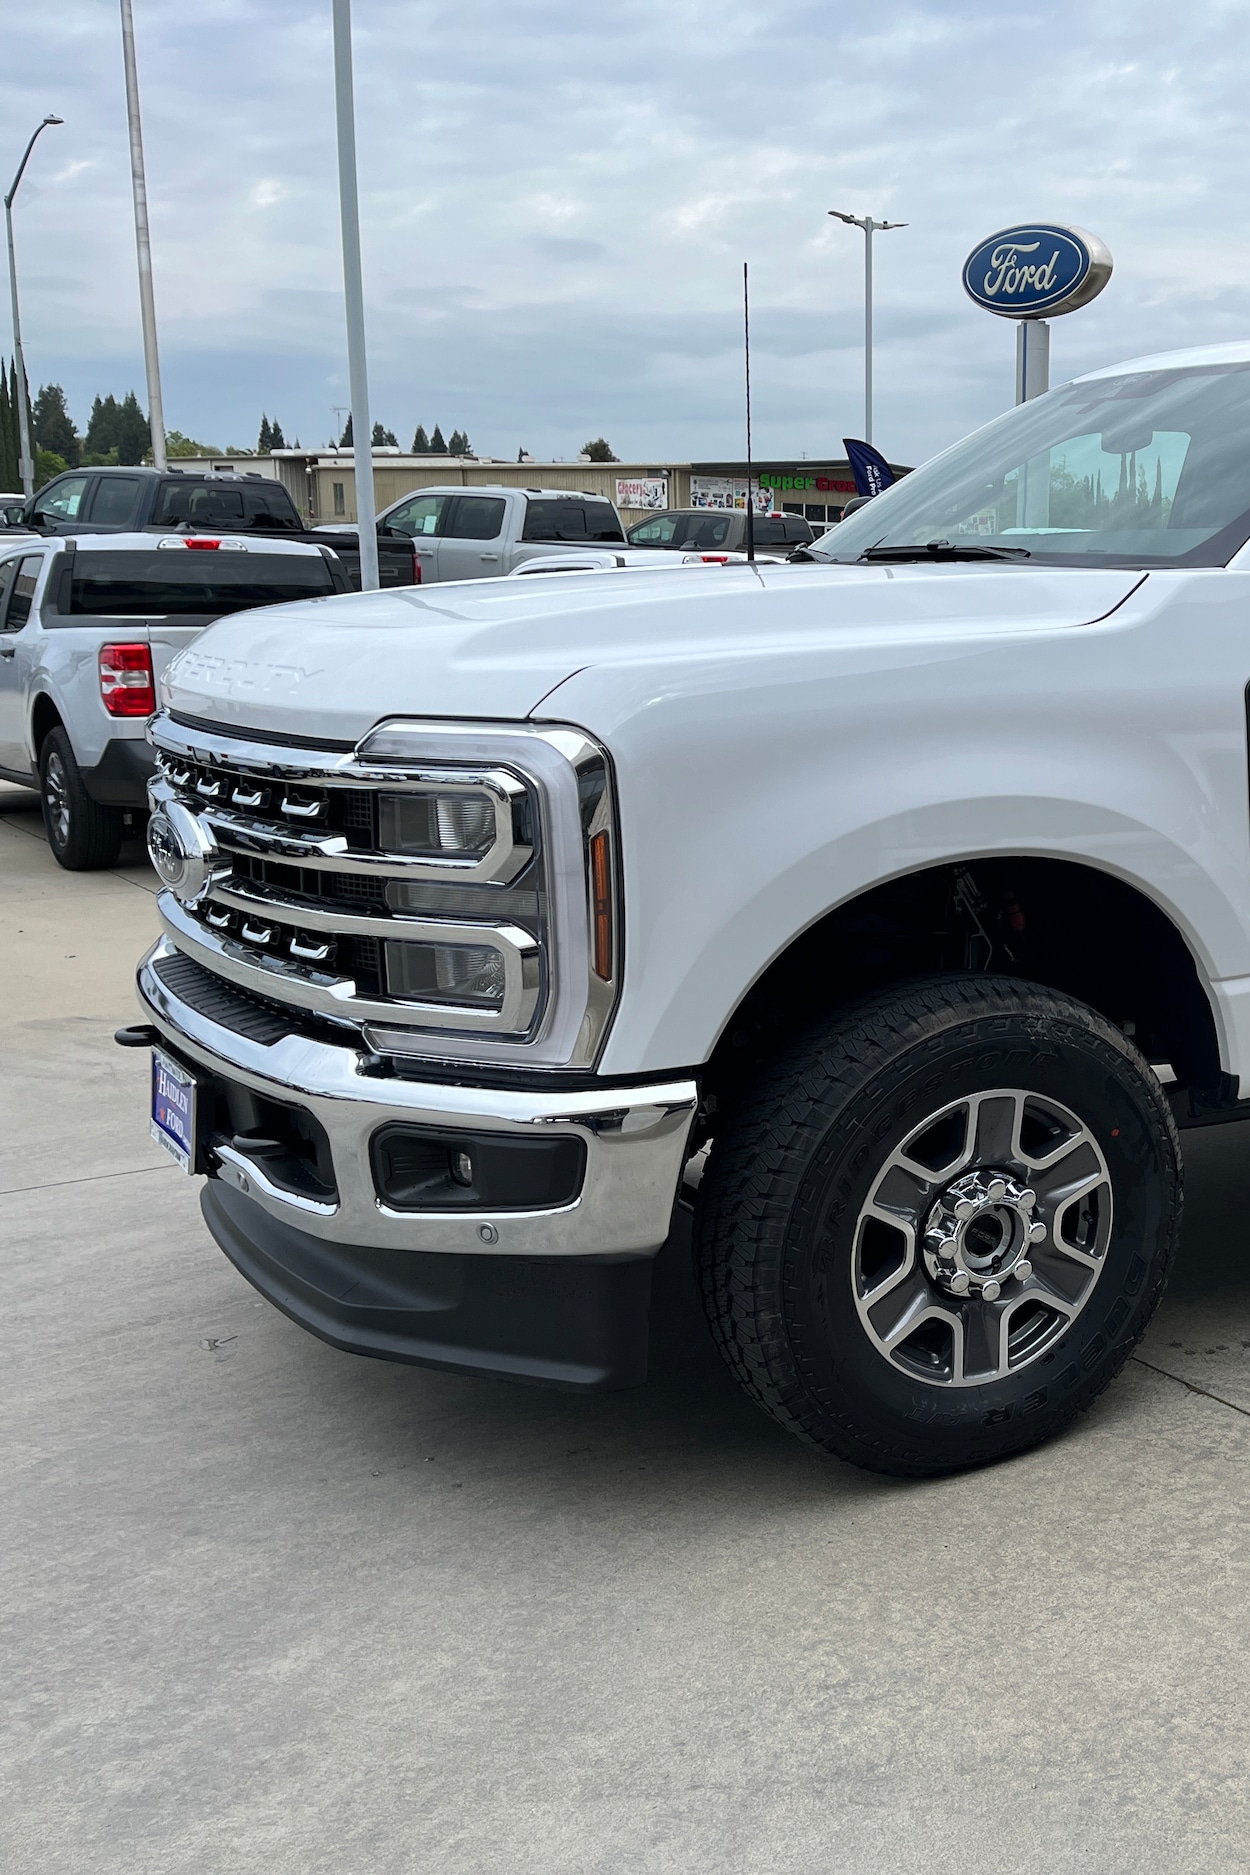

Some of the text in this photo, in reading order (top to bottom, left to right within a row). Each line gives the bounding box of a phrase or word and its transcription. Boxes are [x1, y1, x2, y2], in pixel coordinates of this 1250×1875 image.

[984, 242, 1060, 296] Ford
[759, 473, 814, 491] Super
[815, 477, 858, 493] Groc
[865, 465, 877, 496] Ford Pro
[165, 1108, 184, 1139] FORD
[815, 1047, 1060, 1276] BRIDGESTONE
[980, 1251, 1146, 1428] DUELER
